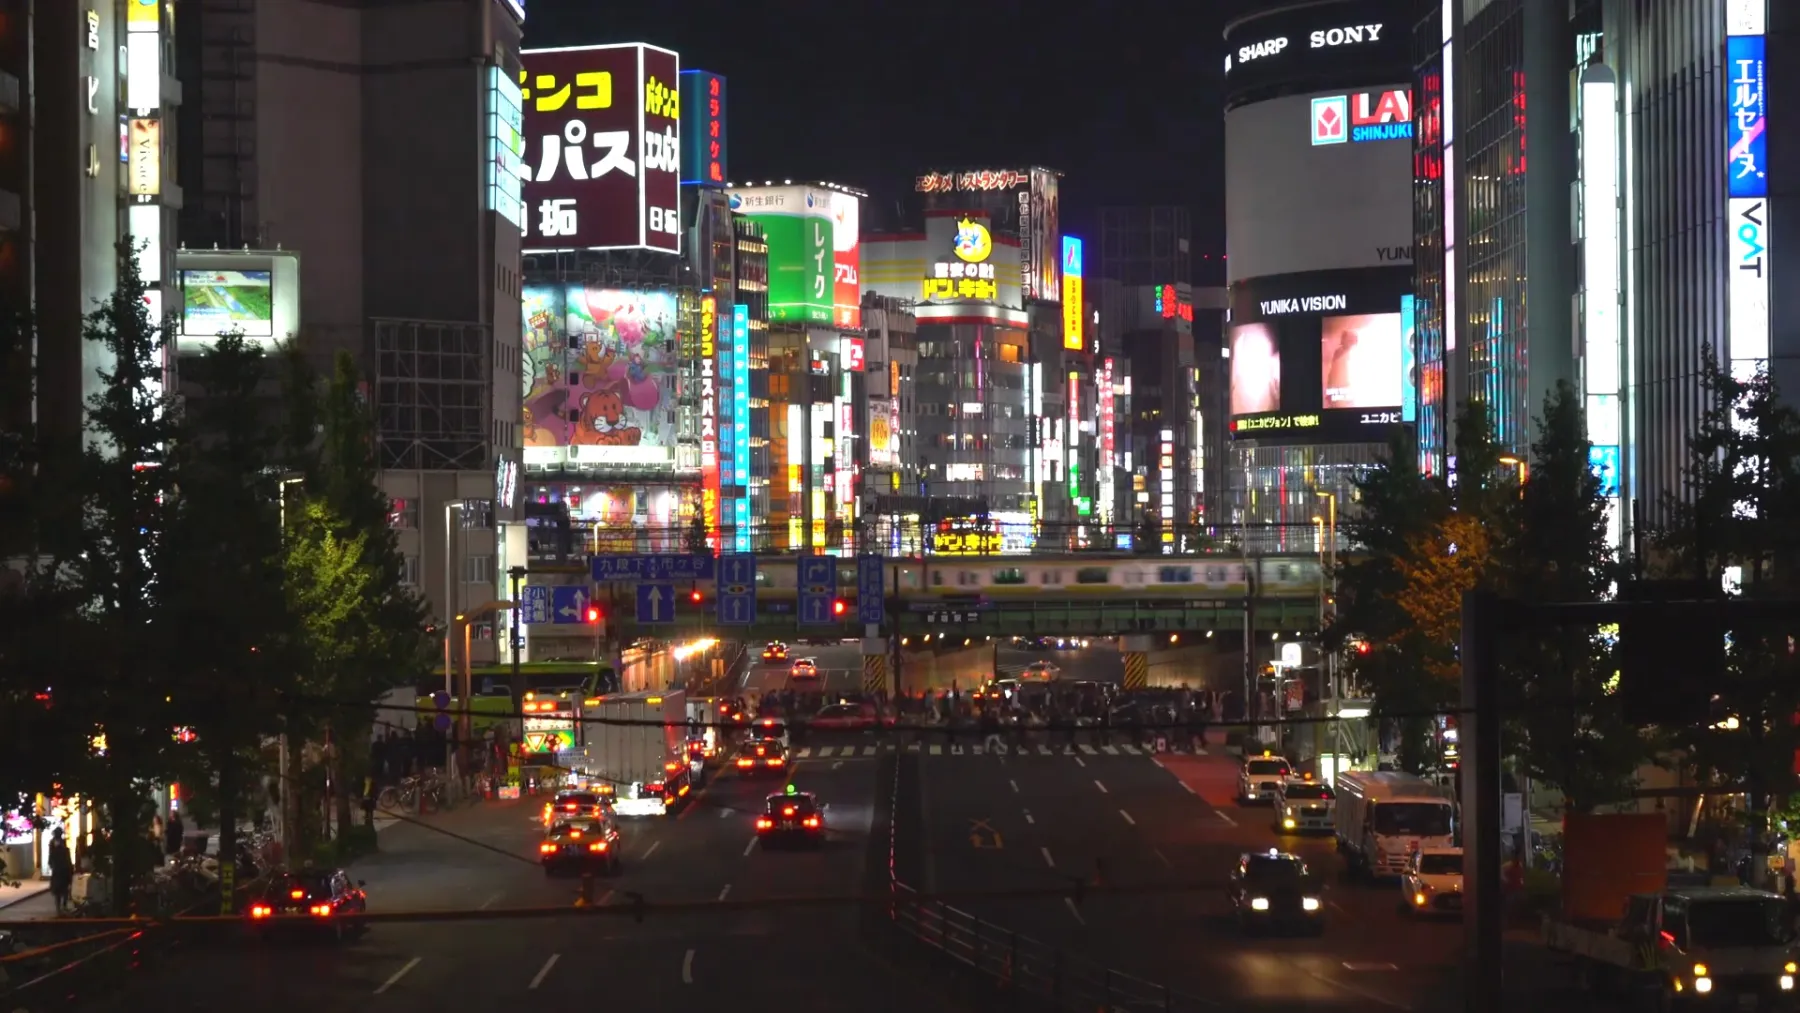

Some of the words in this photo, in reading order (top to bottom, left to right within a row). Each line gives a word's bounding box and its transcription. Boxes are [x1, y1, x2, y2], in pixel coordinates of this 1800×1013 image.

[1310, 24, 1383, 48] SONY
[1239, 37, 1288, 63] SHARP
[645, 76, 680, 119] パチンコ
[1352, 89, 1413, 125] LA
[1732, 59, 1757, 179] エルセーヌ
[645, 125, 680, 173] エスパス
[915, 173, 952, 191] エンタメ
[957, 171, 1028, 191] レストランタワー
[745, 195, 785, 206] 新生銀行
[815, 222, 825, 299] レイク
[834, 263, 857, 284] アコム
[1260, 298, 1300, 315] YUNIKA
[1301, 295, 1346, 312] VISION
[702, 298, 713, 355] パチンコ
[600, 558, 645, 572] 九段下
